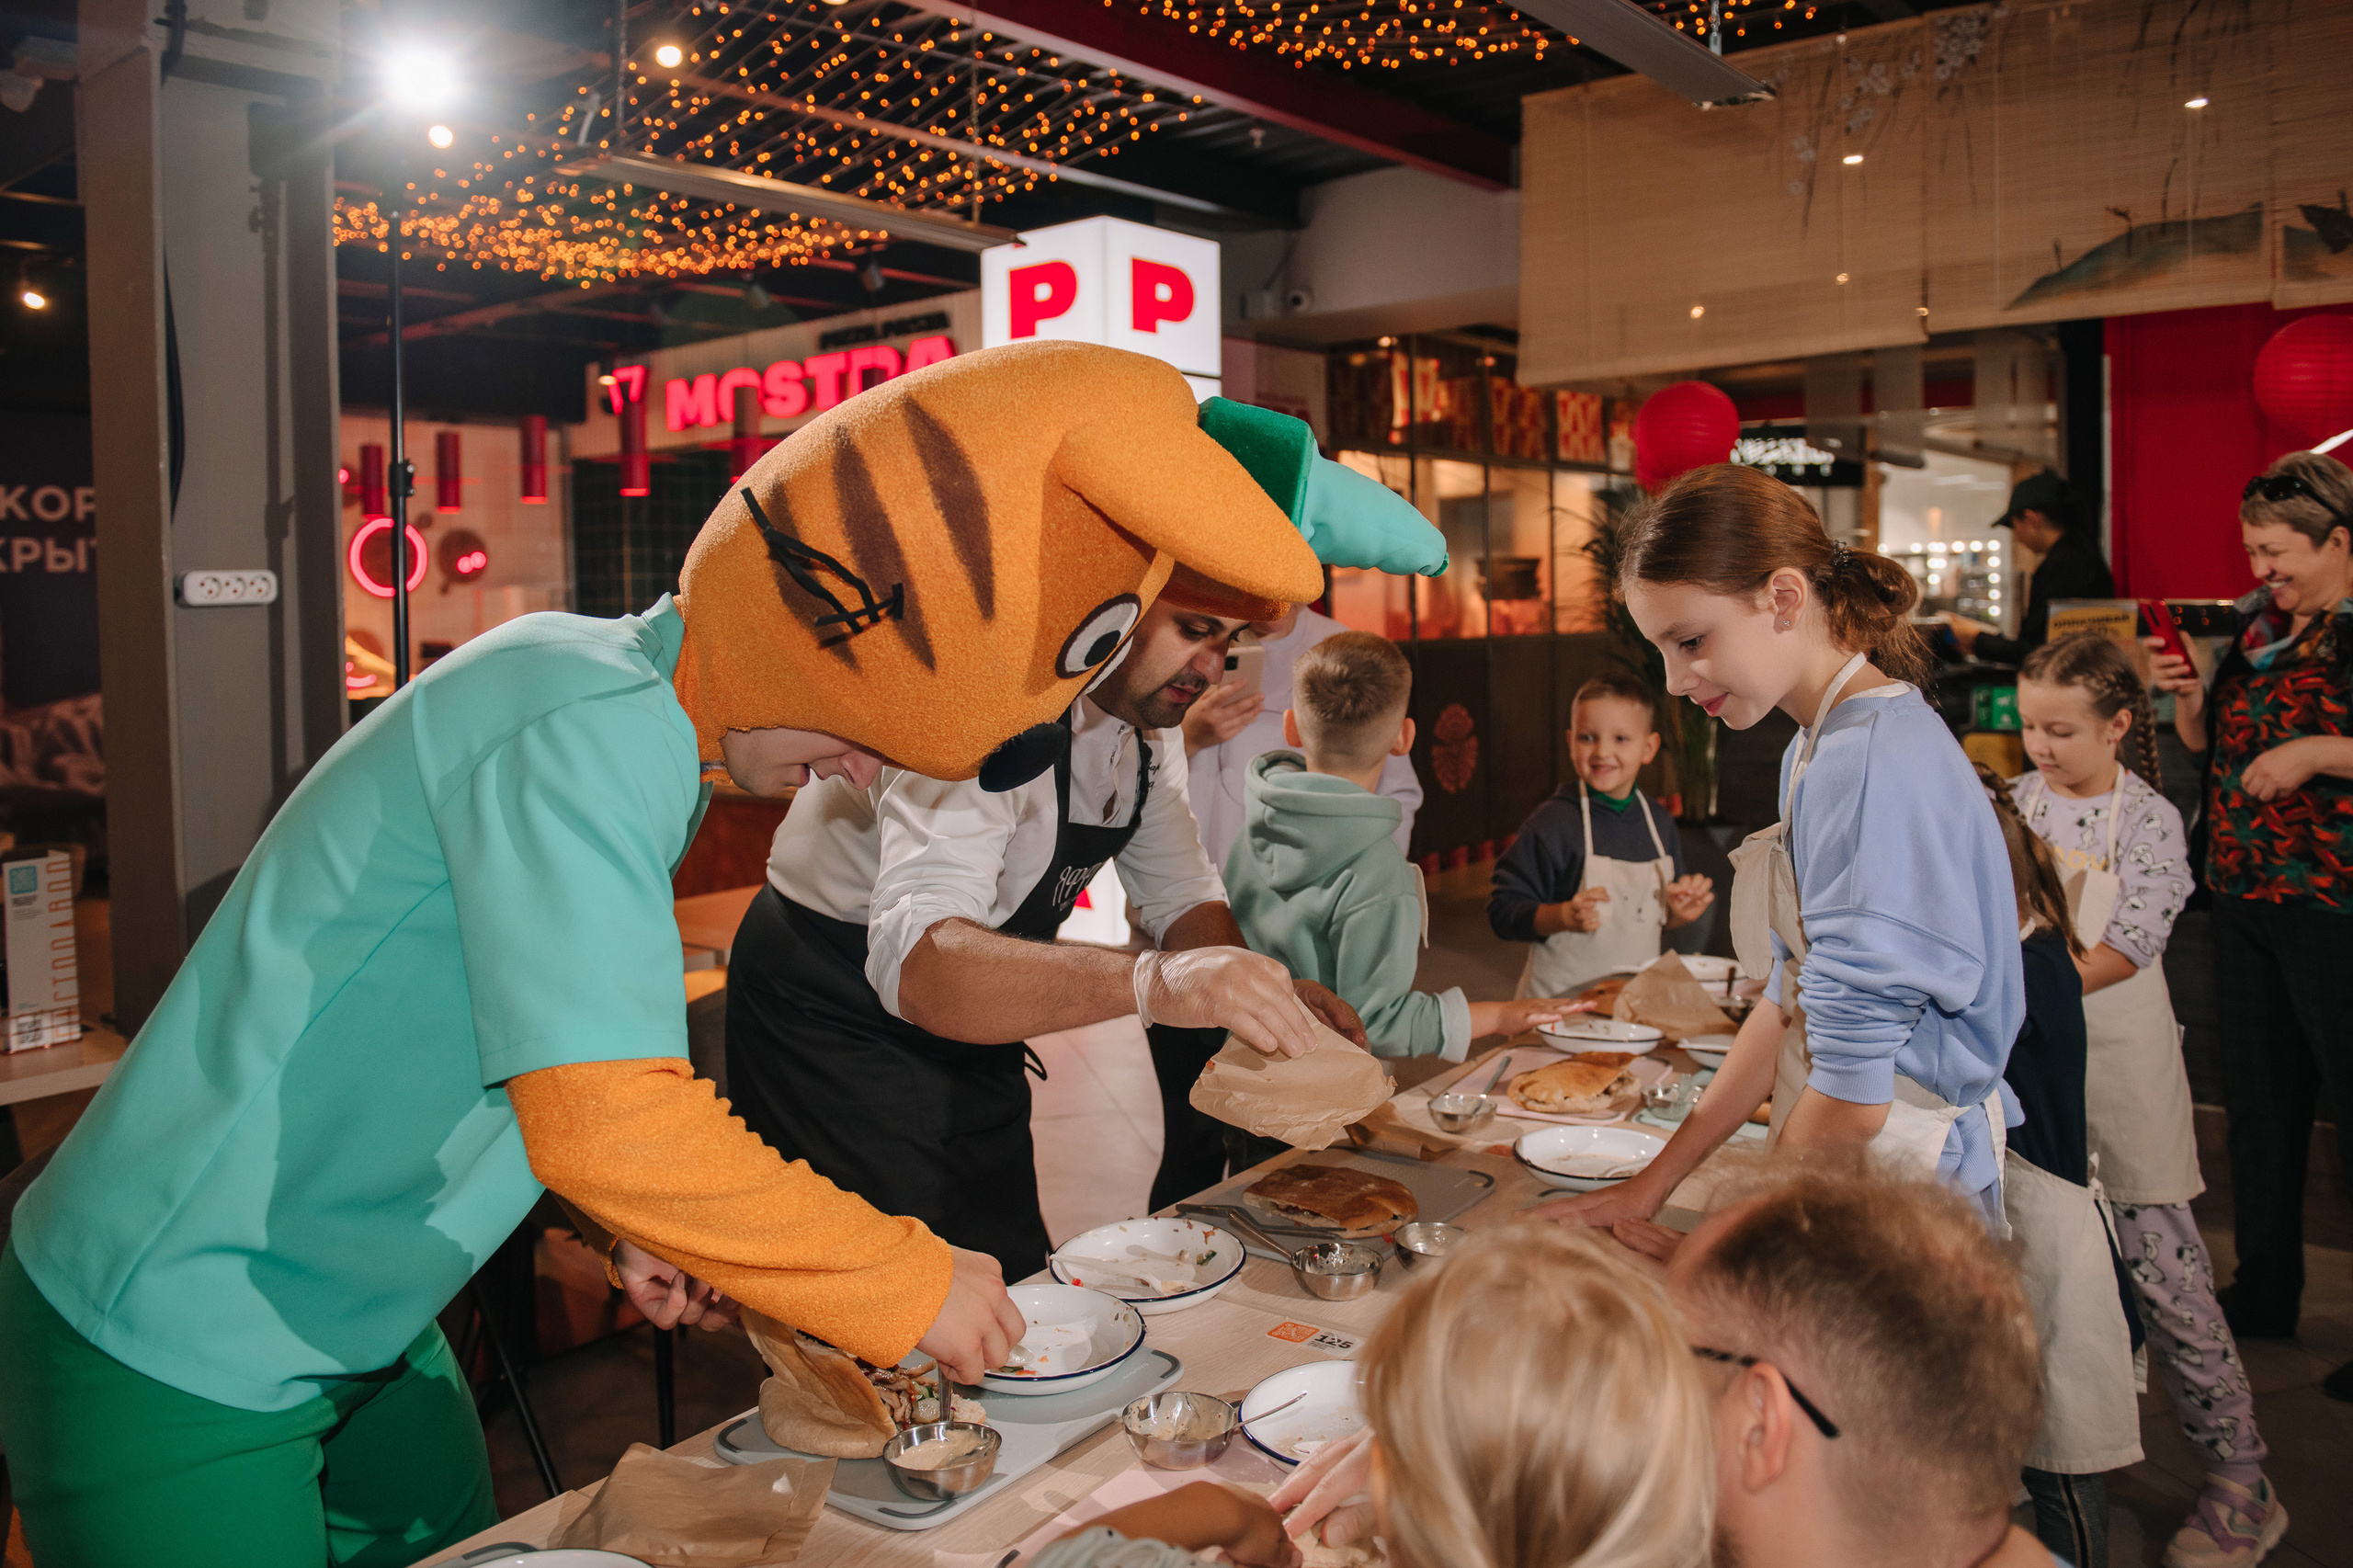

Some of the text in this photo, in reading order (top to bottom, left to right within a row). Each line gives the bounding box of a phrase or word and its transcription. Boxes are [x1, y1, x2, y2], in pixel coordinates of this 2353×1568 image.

[1009, 261, 1077, 340] P
[1131, 257, 1194, 334] P
[1314, 1335, 1354, 1349] 125
